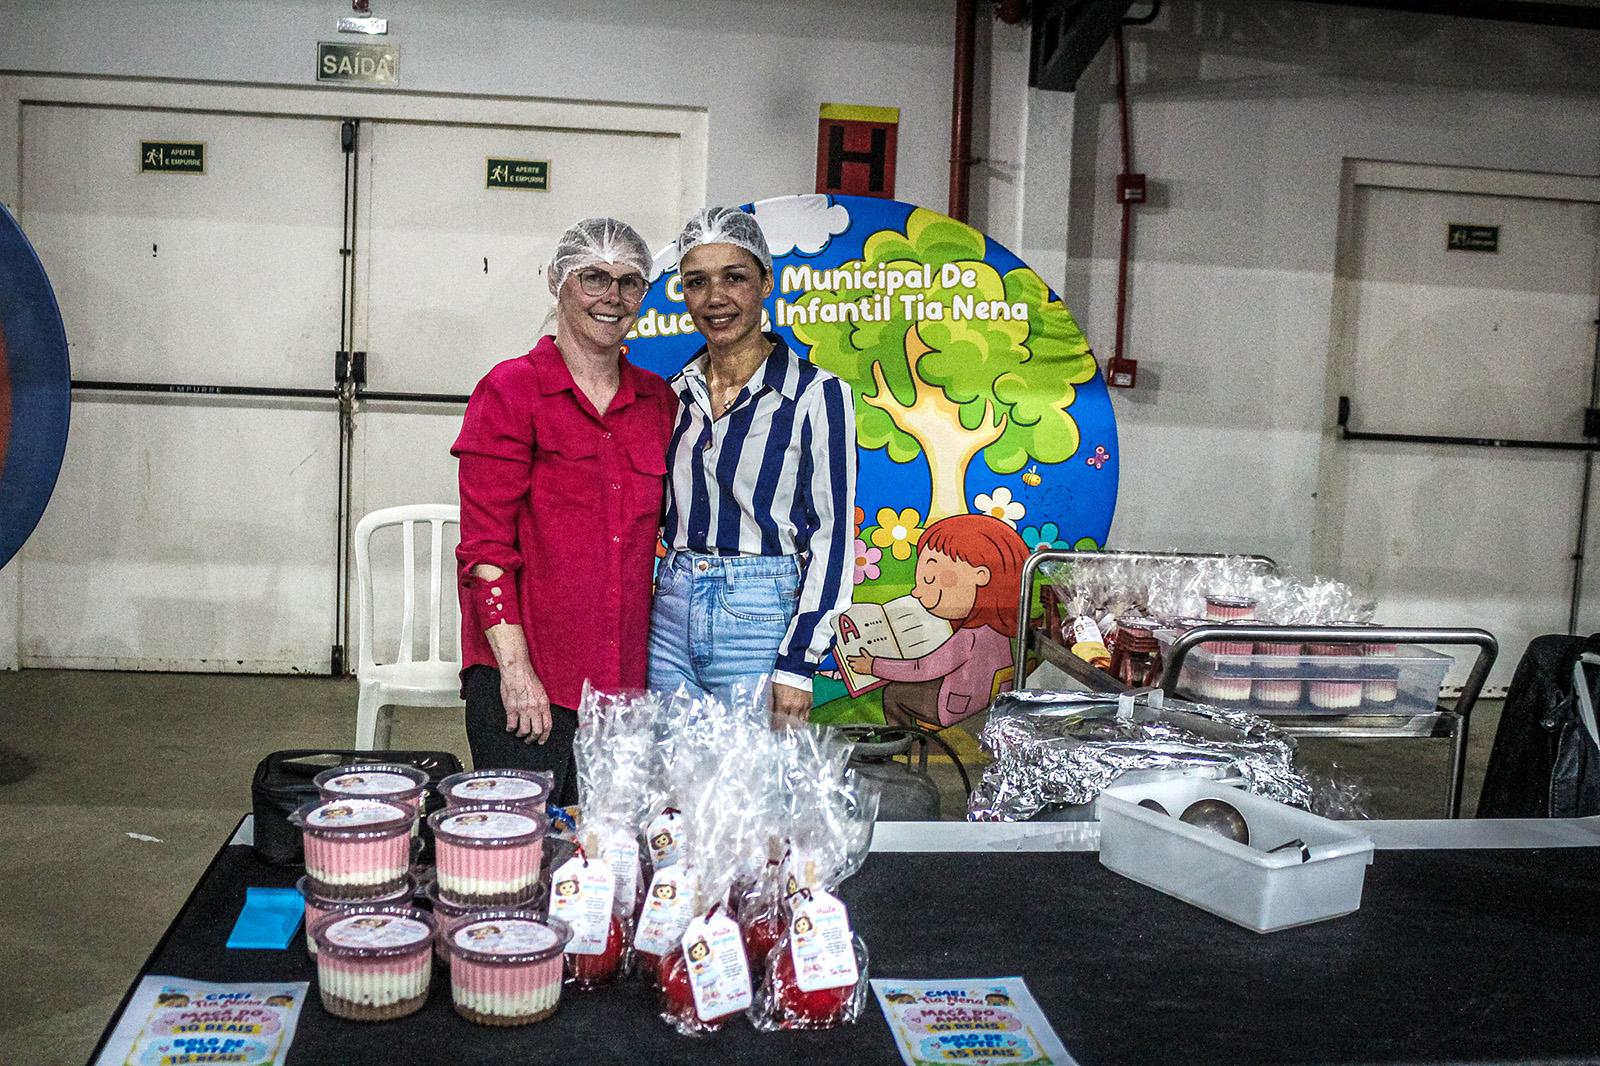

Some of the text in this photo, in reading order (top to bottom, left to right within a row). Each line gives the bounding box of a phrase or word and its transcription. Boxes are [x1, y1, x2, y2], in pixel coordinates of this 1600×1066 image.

[323, 52, 391, 79] SAÍDA
[827, 125, 886, 192] H
[515, 166, 539, 174] APERTE
[515, 175, 544, 183] EMPURRE
[781, 262, 976, 296] Municipal De
[776, 295, 892, 326] Infantil
[899, 294, 943, 321] Tia
[952, 294, 1029, 322] Nena
[839, 613, 861, 645] A
[205, 992, 252, 1000] CMEI
[925, 989, 966, 998] CMEI
[238, 1009, 263, 1017] DO
[181, 1023, 254, 1032] 10 REAIS
[173, 1037, 220, 1048] BOLO
[939, 1034, 1003, 1044] BOLO DE
[171, 1054, 242, 1064] 15 REAIS
[948, 1050, 969, 1058] 15
